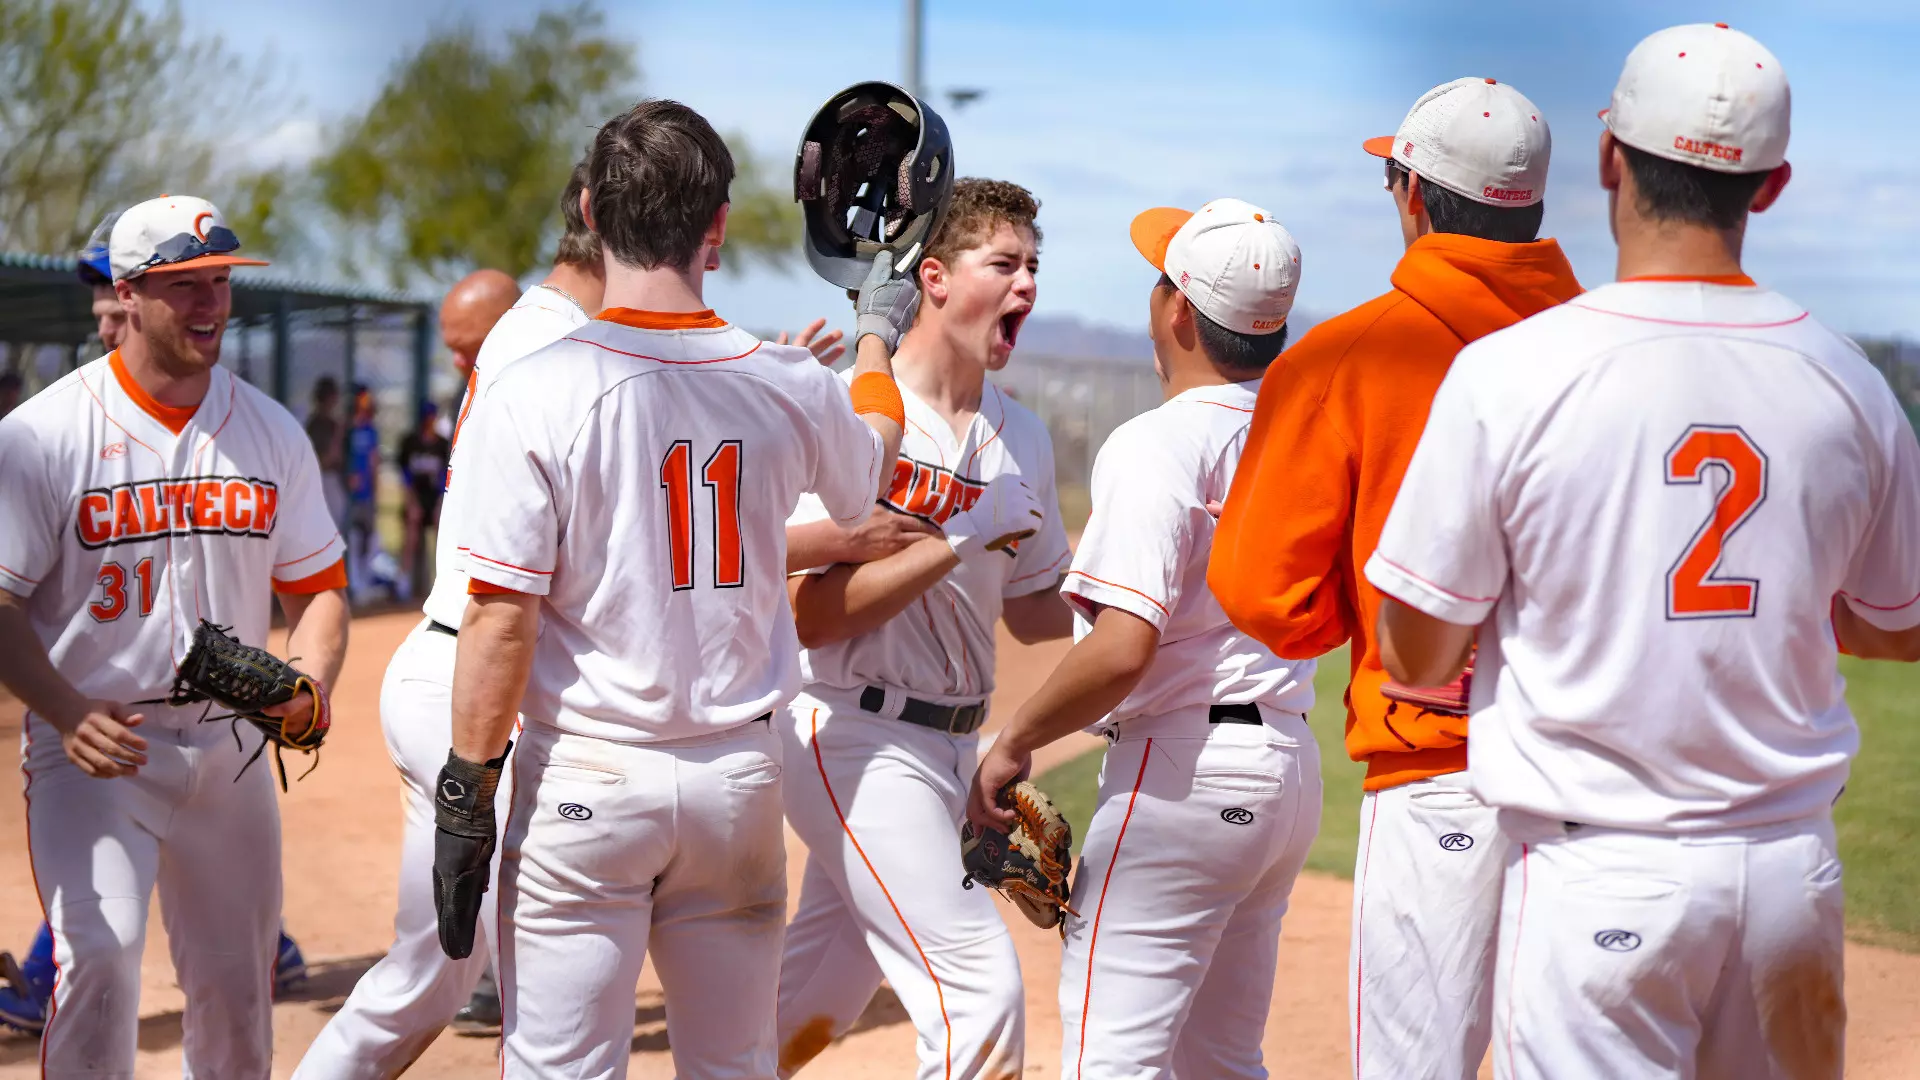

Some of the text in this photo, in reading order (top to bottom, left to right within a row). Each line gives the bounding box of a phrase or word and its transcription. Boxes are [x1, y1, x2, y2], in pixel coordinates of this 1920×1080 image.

[1674, 136, 1743, 161] CALTECH
[1483, 186, 1533, 200] CALTECH
[75, 475, 278, 550] CALTECH
[660, 440, 744, 592] 11
[1664, 424, 1769, 620] 2
[88, 557, 153, 623] 31
